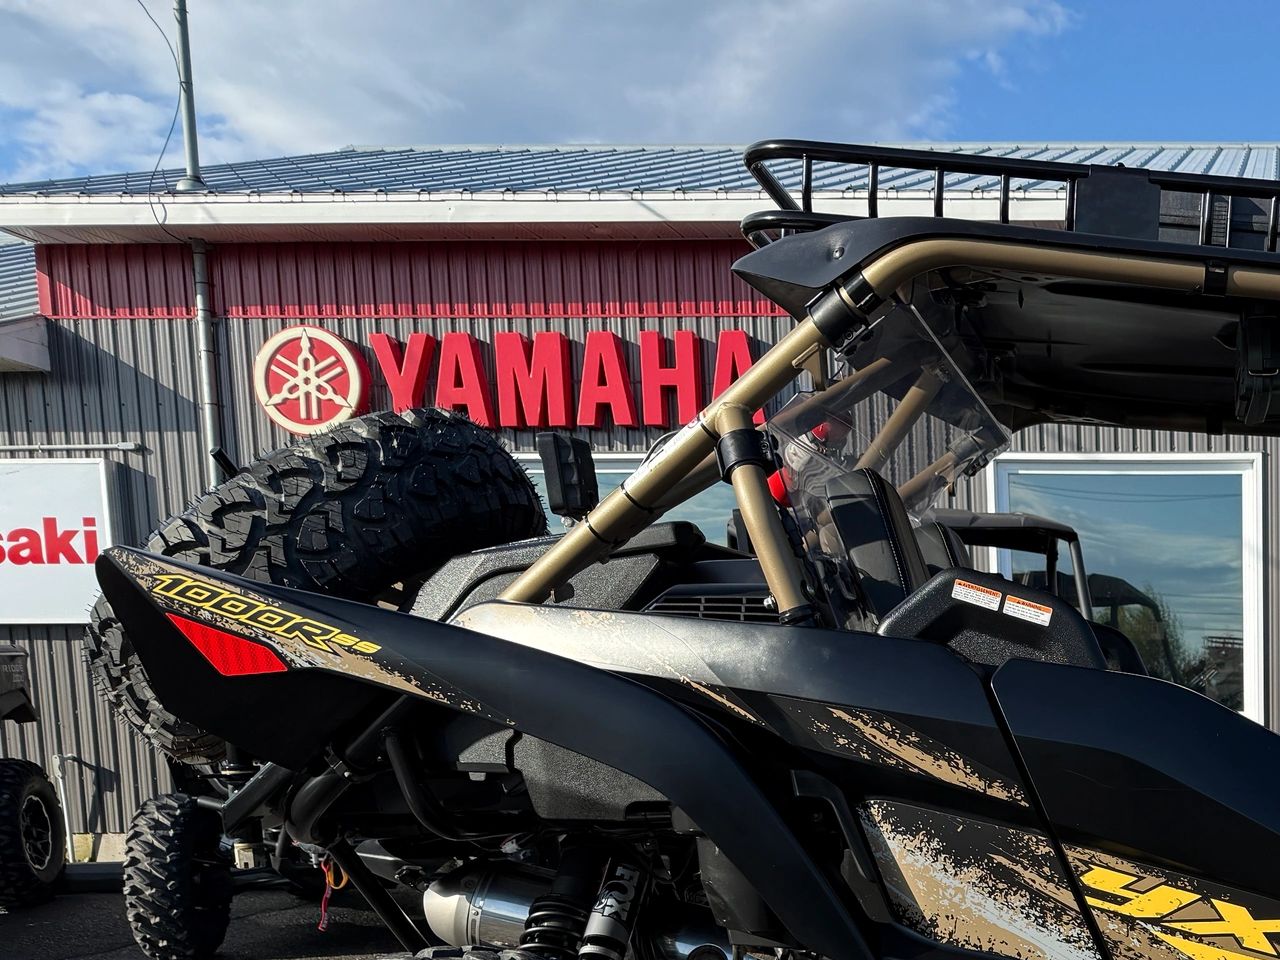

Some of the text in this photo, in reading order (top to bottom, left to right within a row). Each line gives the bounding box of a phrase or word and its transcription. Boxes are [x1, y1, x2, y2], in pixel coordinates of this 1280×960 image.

[369, 331, 766, 428] YAMAHA
[0, 517, 98, 565] aki
[152, 574, 342, 654] 1000R
